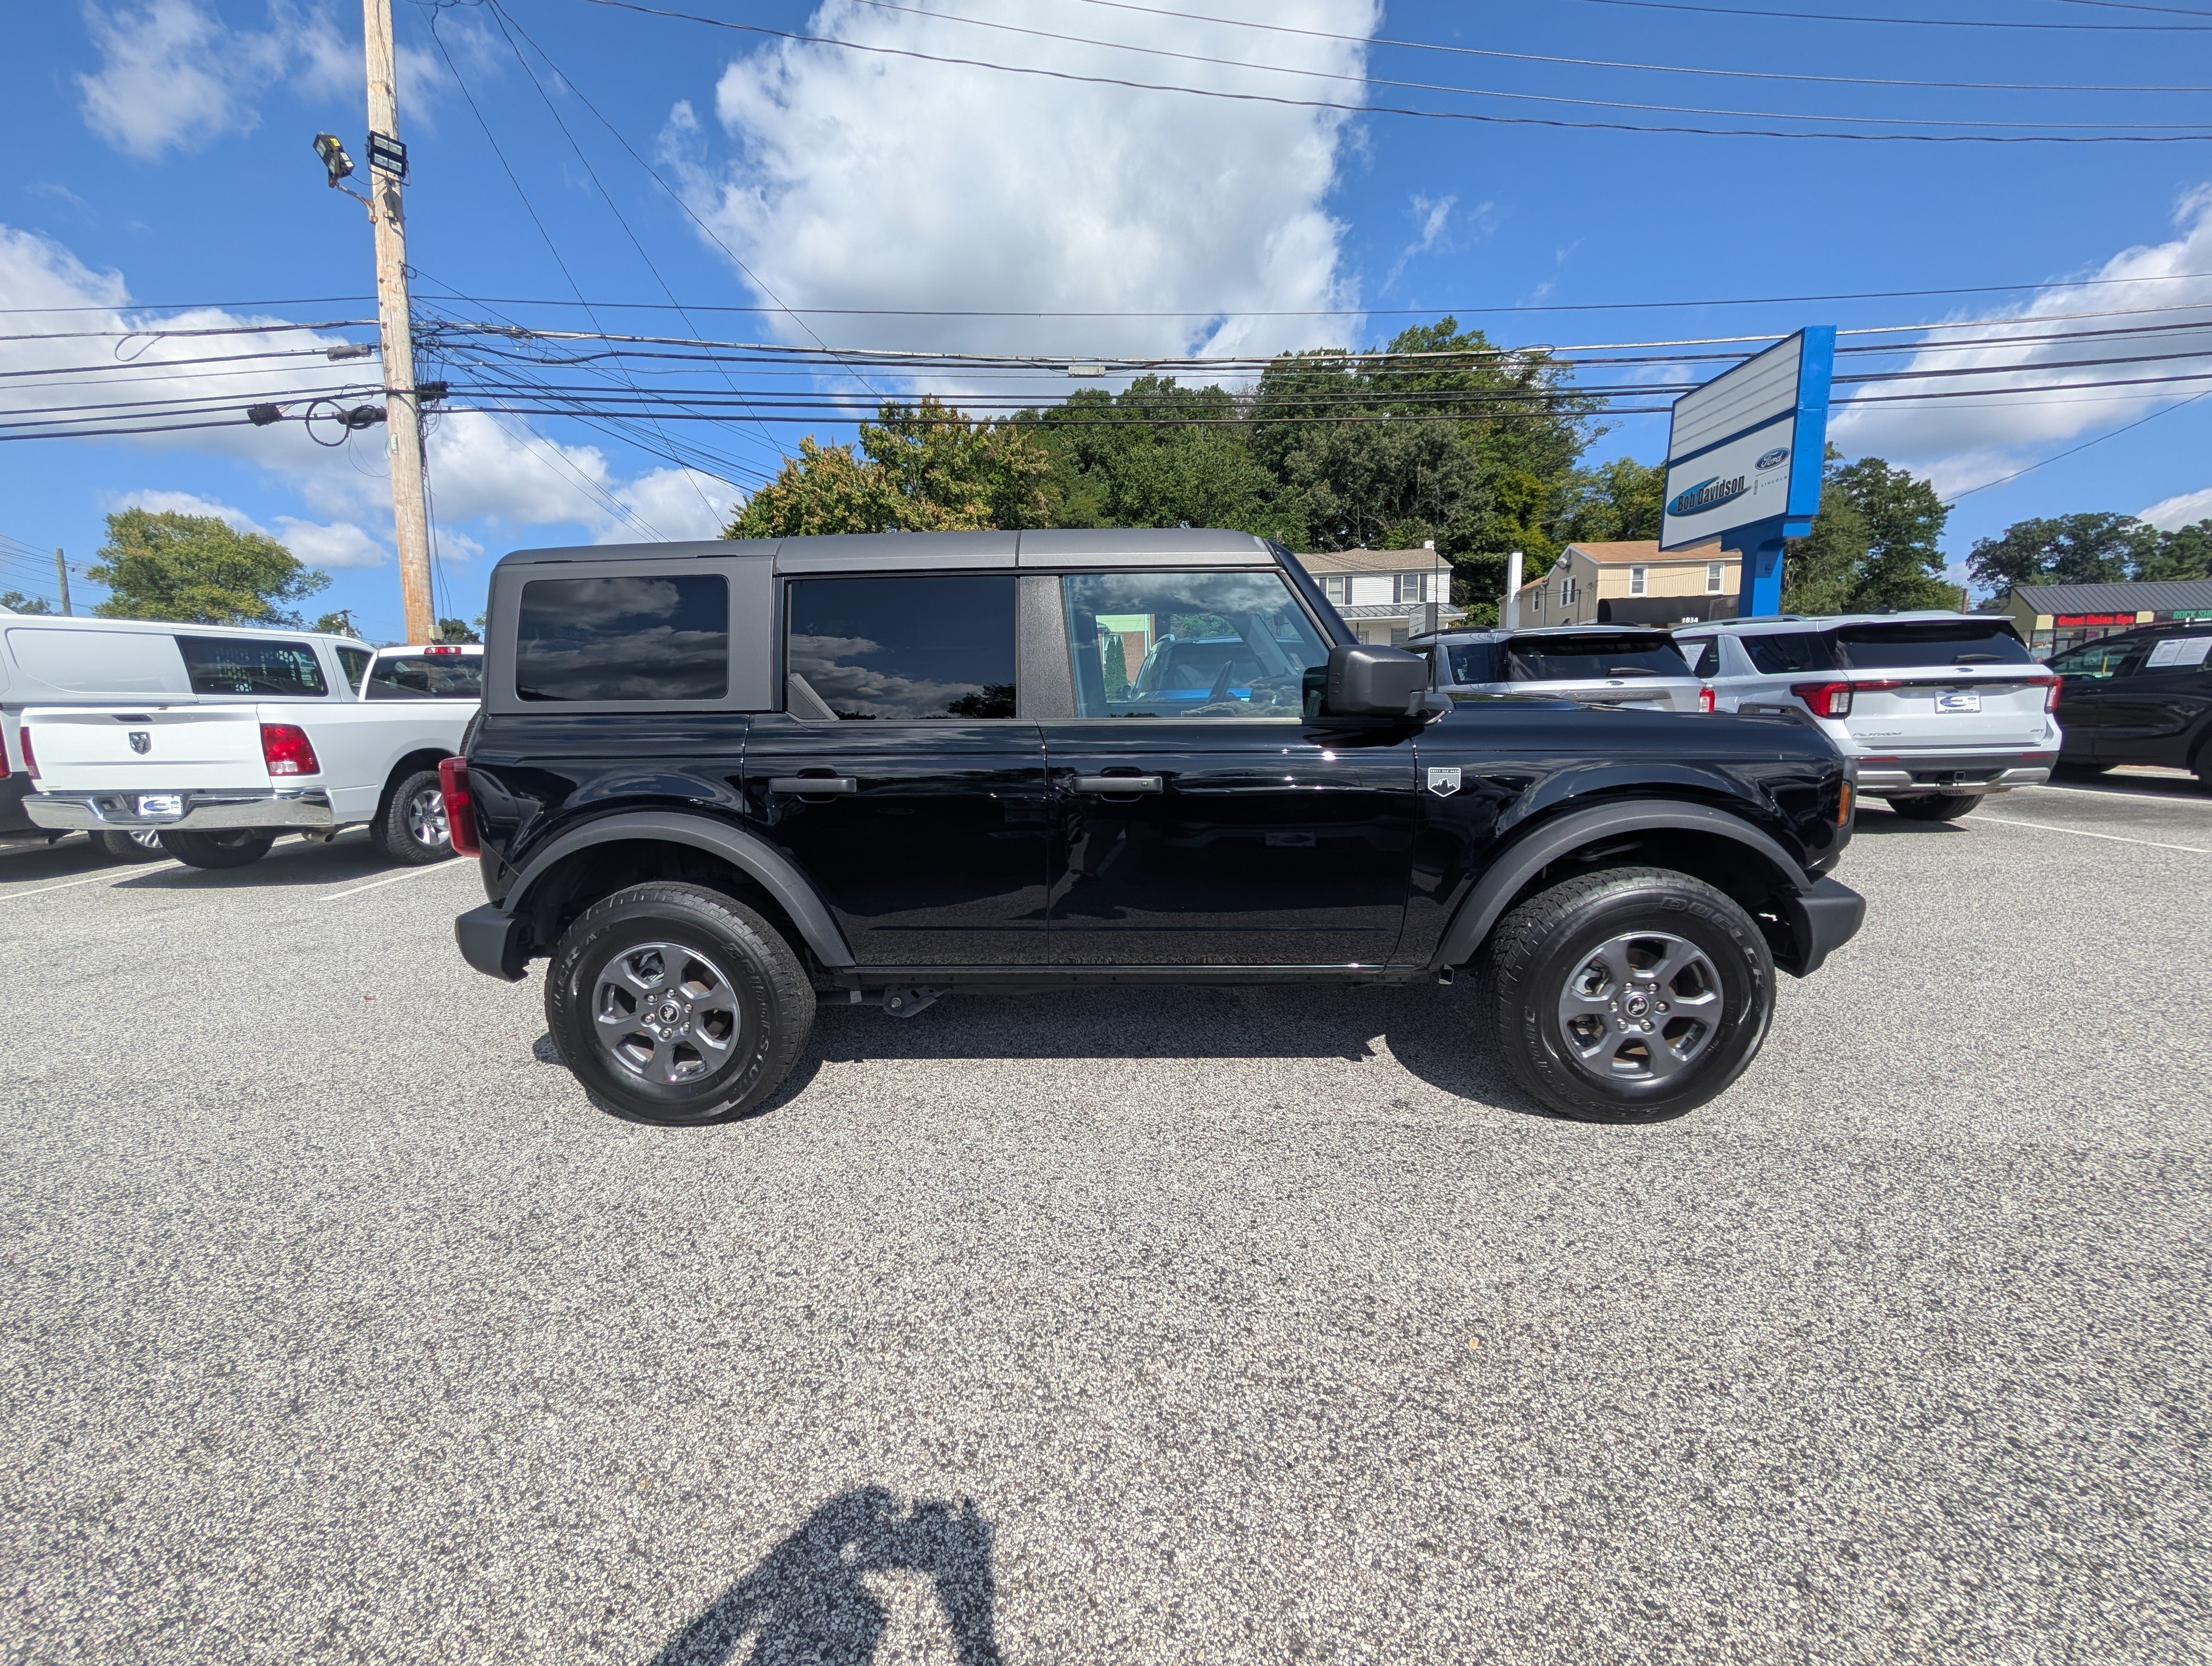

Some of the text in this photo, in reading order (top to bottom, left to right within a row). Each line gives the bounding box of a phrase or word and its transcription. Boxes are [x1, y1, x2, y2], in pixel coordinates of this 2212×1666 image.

[1761, 476, 1787, 488] LINCOLN
[1677, 475, 1745, 512] Bob Davidson
[2115, 613, 2134, 626] Spa
